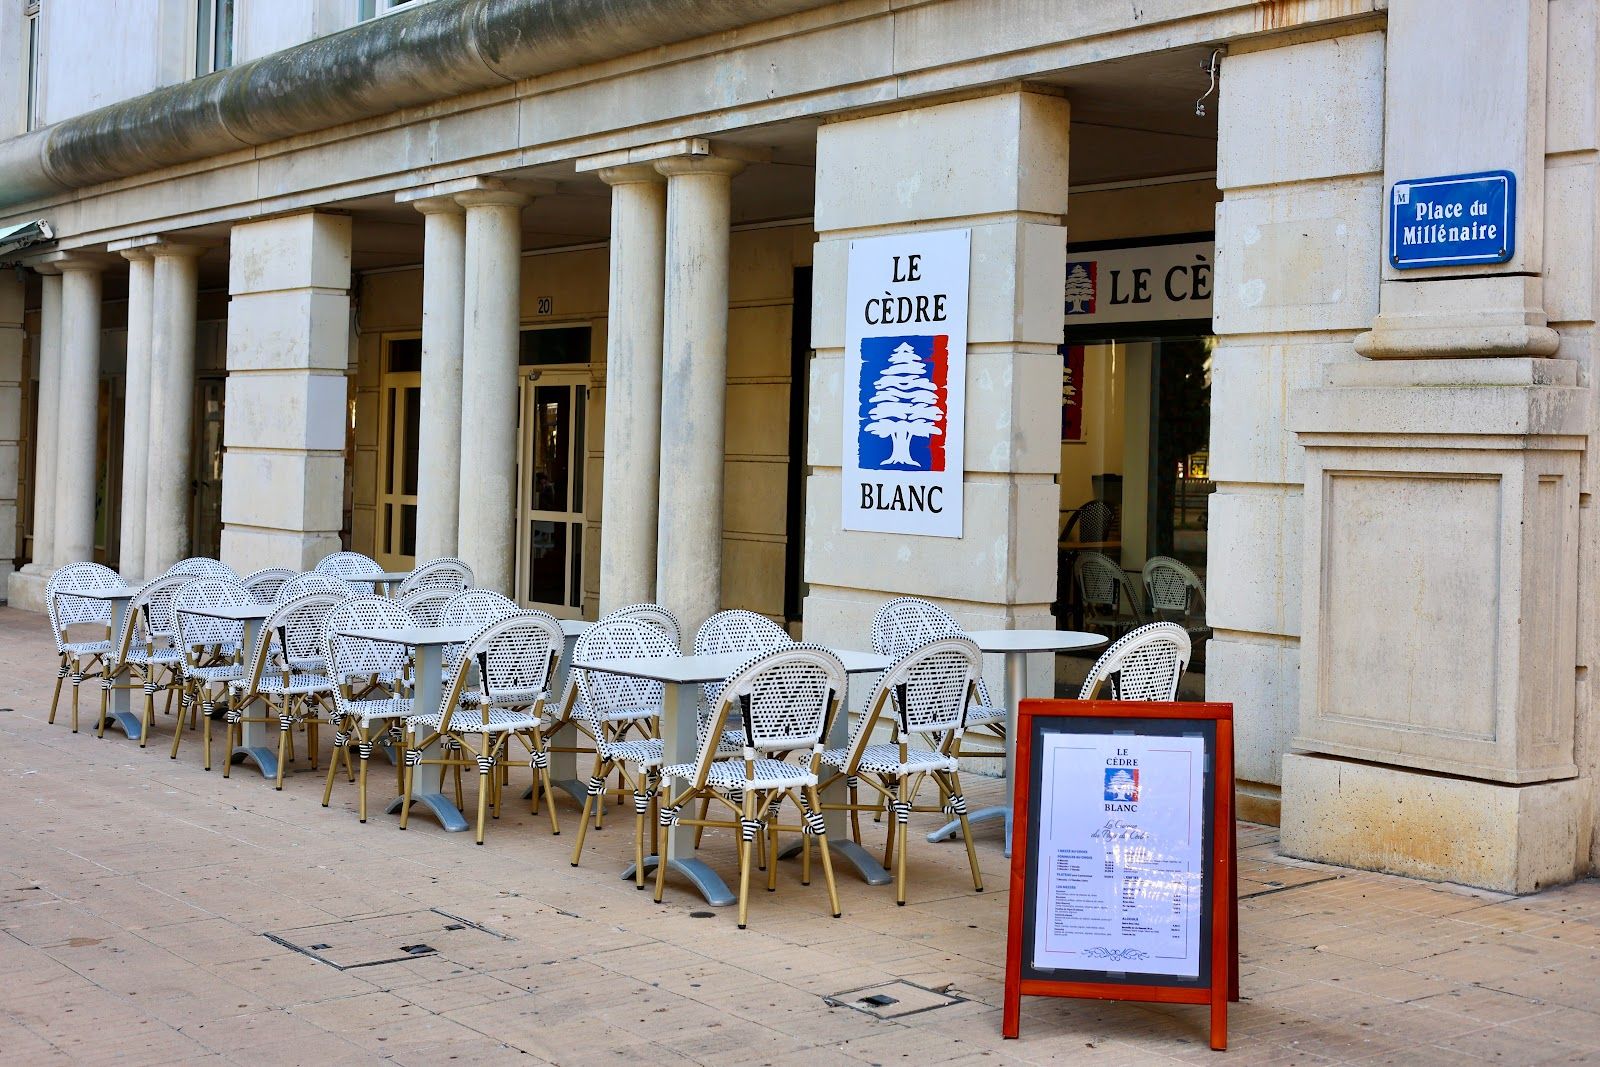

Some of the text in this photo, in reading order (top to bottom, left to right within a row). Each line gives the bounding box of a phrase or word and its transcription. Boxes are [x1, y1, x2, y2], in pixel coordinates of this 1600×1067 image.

[1416, 200, 1488, 221] Place du
[1403, 221, 1497, 245] Millénaire
[892, 255, 921, 282] LE
[1110, 268, 1152, 304] LE
[538, 299, 550, 313] 20
[865, 291, 947, 325] CÈDRE
[860, 483, 943, 513] BLANC
[1106, 757, 1139, 766] CÈDRE
[1117, 748, 1129, 756] LE
[1104, 803, 1138, 812] BLANC
